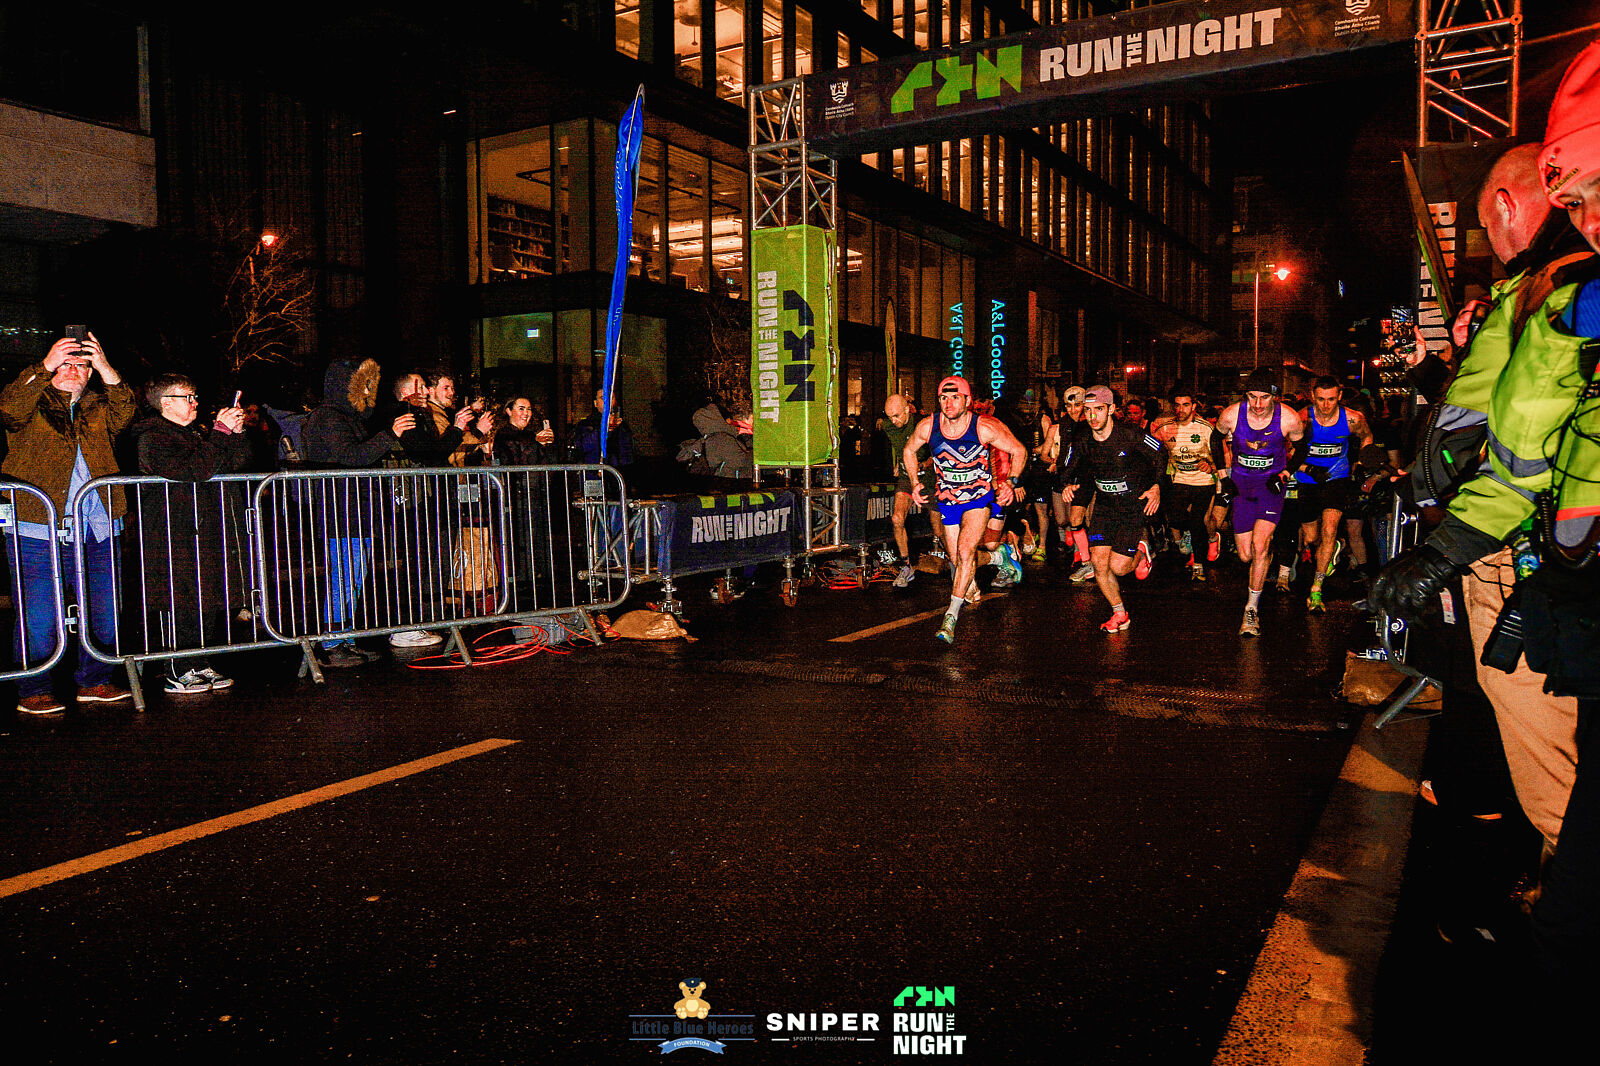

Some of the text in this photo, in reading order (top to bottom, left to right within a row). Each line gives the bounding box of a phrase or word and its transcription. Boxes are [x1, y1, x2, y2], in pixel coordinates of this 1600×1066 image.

[1040, 7, 1282, 82] RUN THE NIGHT
[991, 299, 1006, 332] A&L
[757, 270, 780, 423] RUN THE NIGHT
[951, 473, 968, 481] 417
[691, 514, 726, 543] RUN
[733, 506, 791, 540] NIGHT
